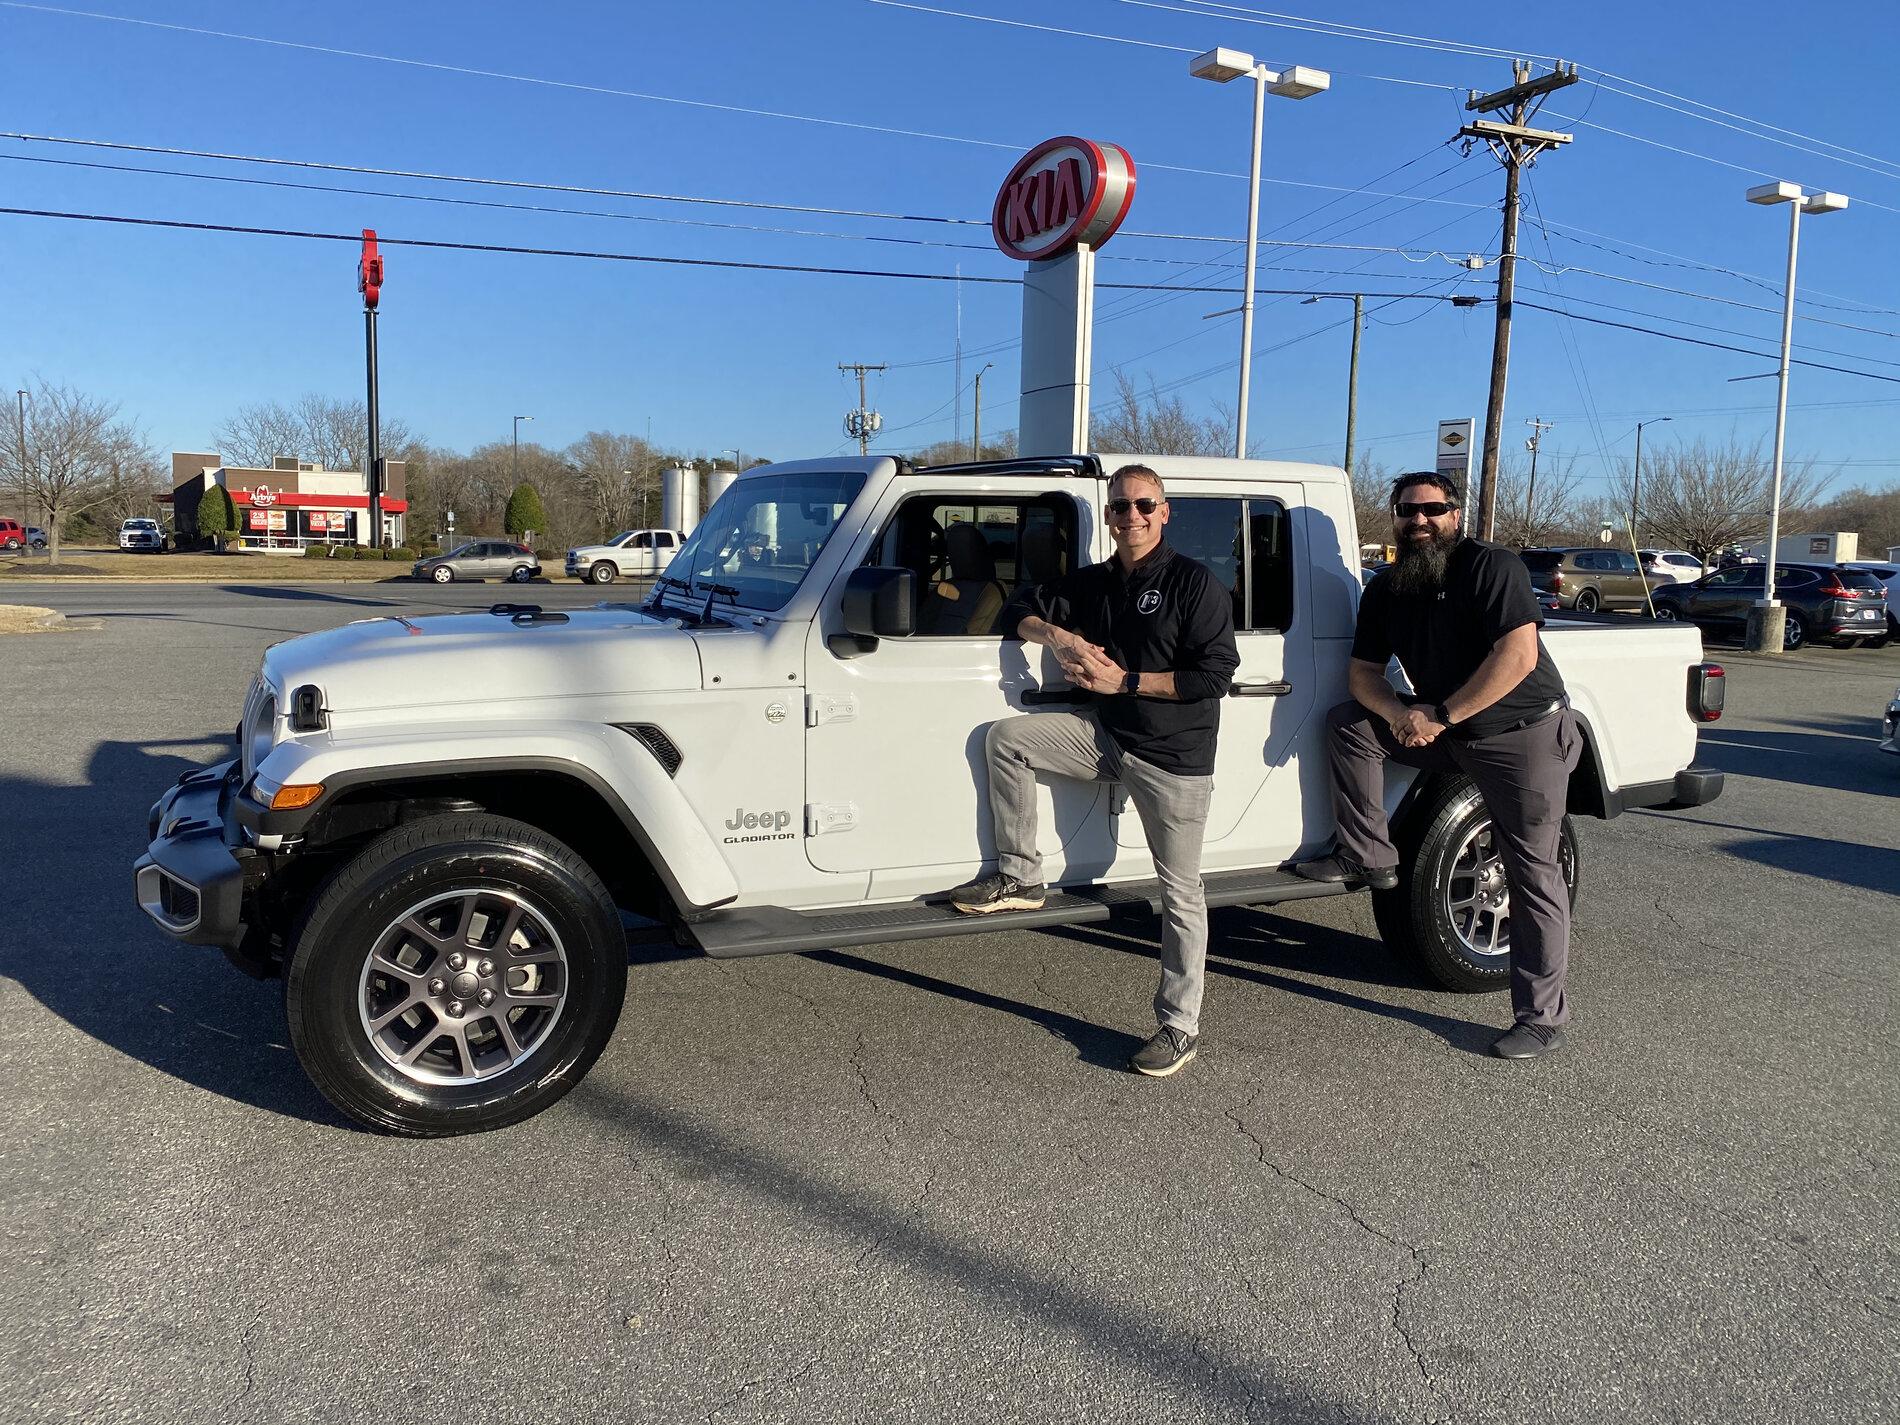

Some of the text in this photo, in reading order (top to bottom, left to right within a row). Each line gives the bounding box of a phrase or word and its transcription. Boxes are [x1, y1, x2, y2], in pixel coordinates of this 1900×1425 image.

[1009, 158, 1084, 243] KIA
[250, 492, 276, 503] Arby's
[725, 808, 791, 831] Jeep
[723, 832, 795, 844] GLADIATOR
